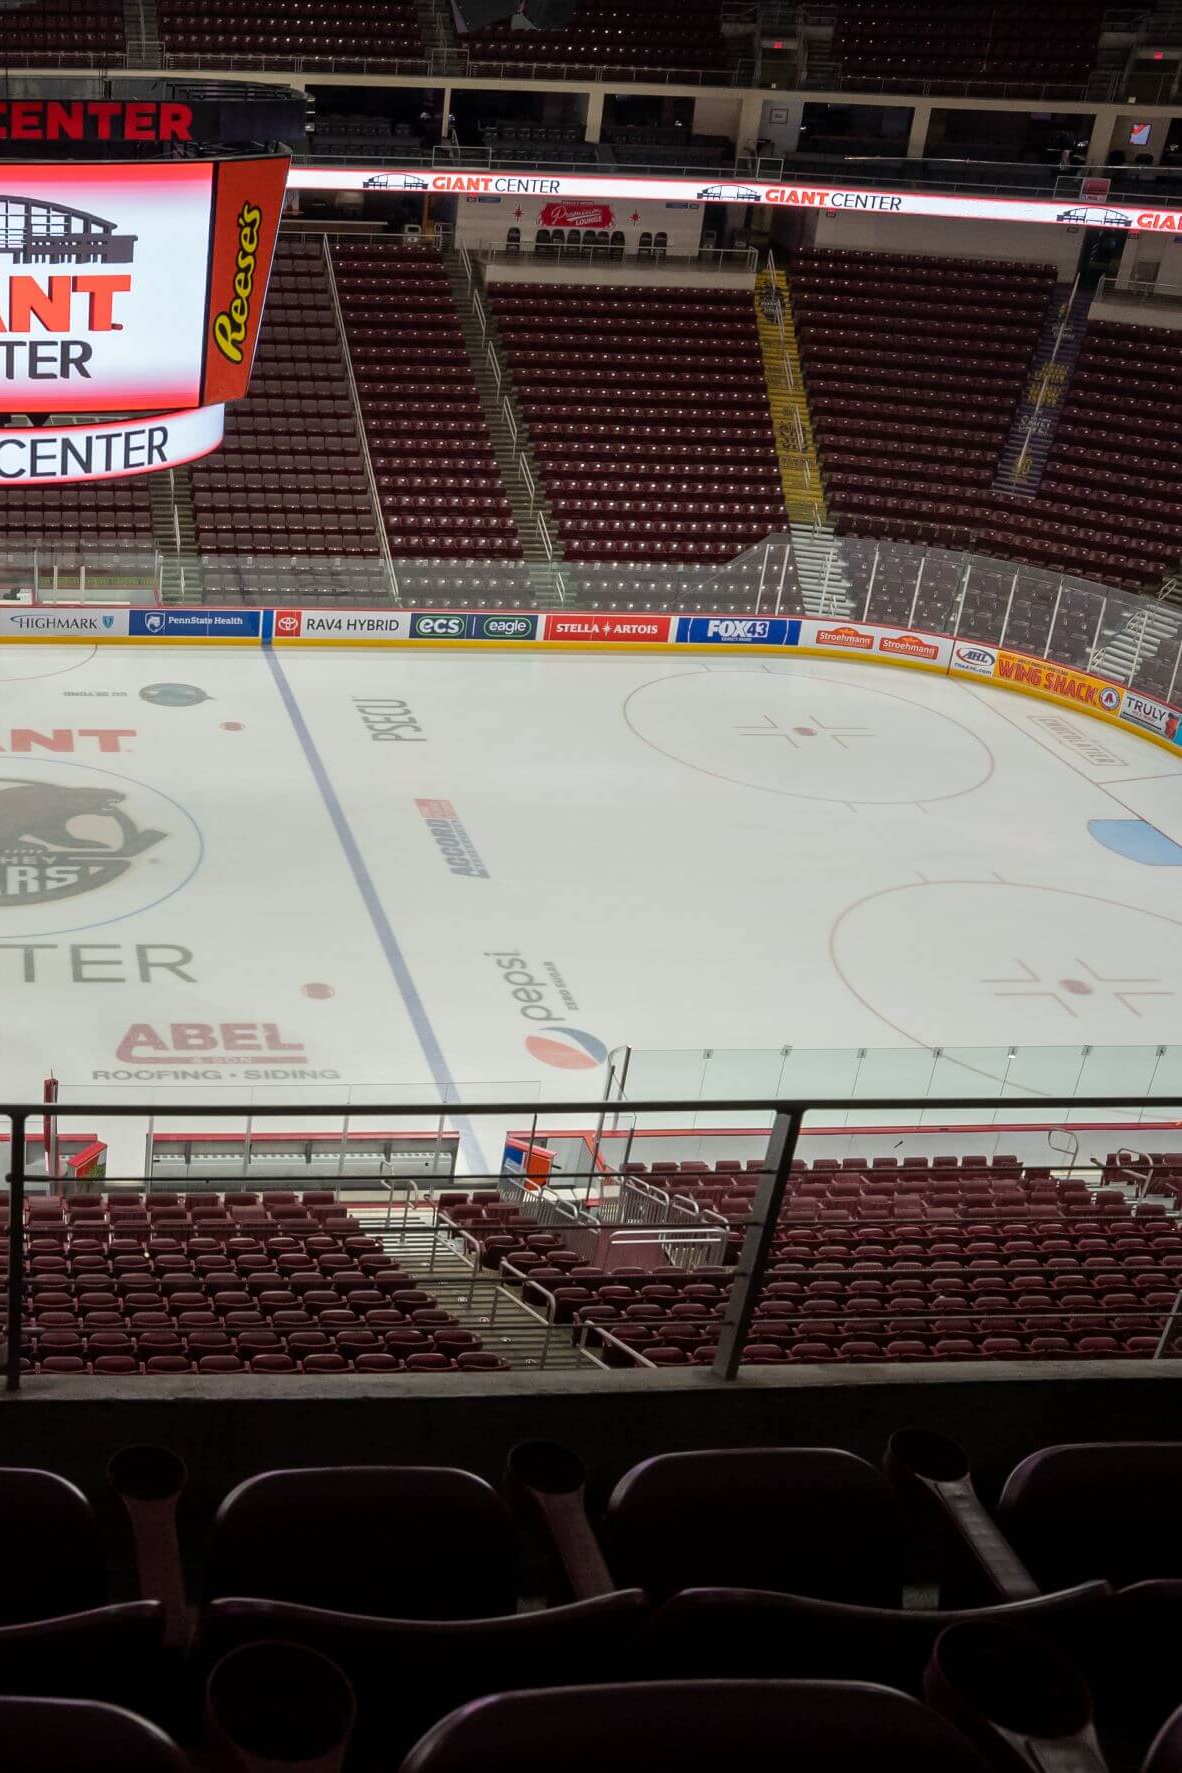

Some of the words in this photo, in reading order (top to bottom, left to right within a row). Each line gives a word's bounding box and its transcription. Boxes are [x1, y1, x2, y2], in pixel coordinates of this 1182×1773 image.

[432, 176, 491, 191] GIANT
[495, 179, 560, 193] CENTER
[765, 189, 829, 205] GIANT
[831, 193, 902, 211] CENTER
[1137, 213, 1182, 230] GIA
[214, 203, 261, 363] Reese's
[19, 616, 98, 629] HIGHMARK
[214, 616, 243, 625] Health
[307, 618, 342, 631] RAV4
[346, 618, 399, 631] HYBRID
[418, 618, 459, 633] ecs
[488, 619, 527, 634] eagle
[555, 623, 599, 633] STELLA
[613, 624, 658, 634] ARTOIS
[819, 632, 870, 645] Stroehmann
[882, 639, 934, 656] Stroehmann
[963, 649, 989, 662] AHL
[998, 659, 1042, 686] WING
[1045, 673, 1097, 704] SHACK
[1127, 696, 1166, 721] TRULY
[352, 698, 427, 742] PSECU
[482, 951, 566, 1021] pepsi
[116, 1023, 305, 1056] ABEL
[92, 1070, 222, 1081] ROOFING
[244, 1069, 341, 1080] SIDING
